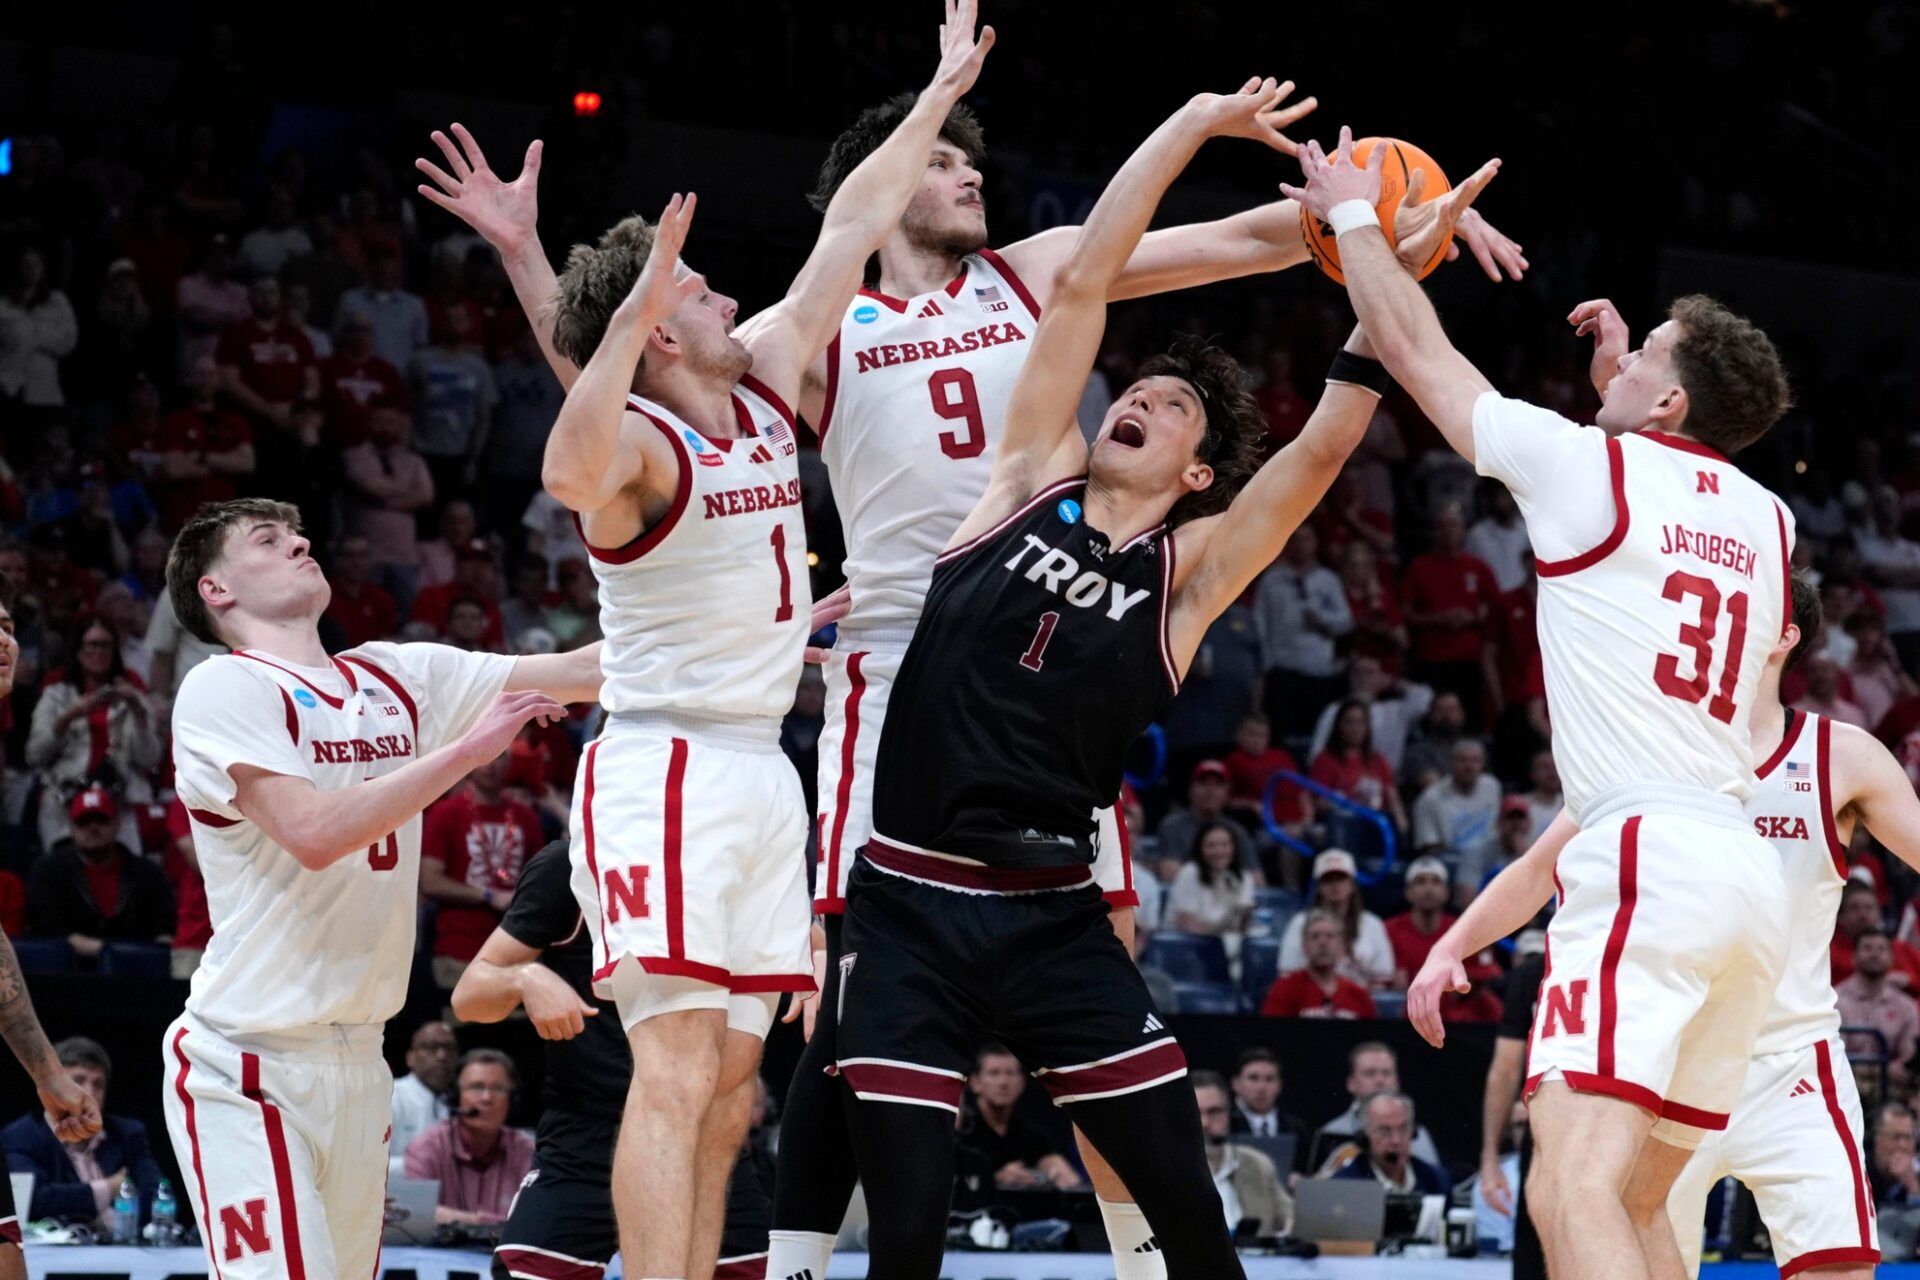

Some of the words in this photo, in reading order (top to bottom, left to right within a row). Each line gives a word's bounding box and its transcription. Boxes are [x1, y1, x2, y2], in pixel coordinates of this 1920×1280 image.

[855, 322, 1026, 374] NEBRASKA
[927, 367, 986, 460] 9
[1696, 471, 1720, 494] N
[770, 523, 793, 623] 1
[1004, 533, 1151, 622] TROY
[1019, 611, 1060, 673] 1
[1653, 570, 1749, 725] 31
[603, 864, 651, 925] N
[1540, 977, 1590, 1040] N
[219, 1196, 272, 1263] N
